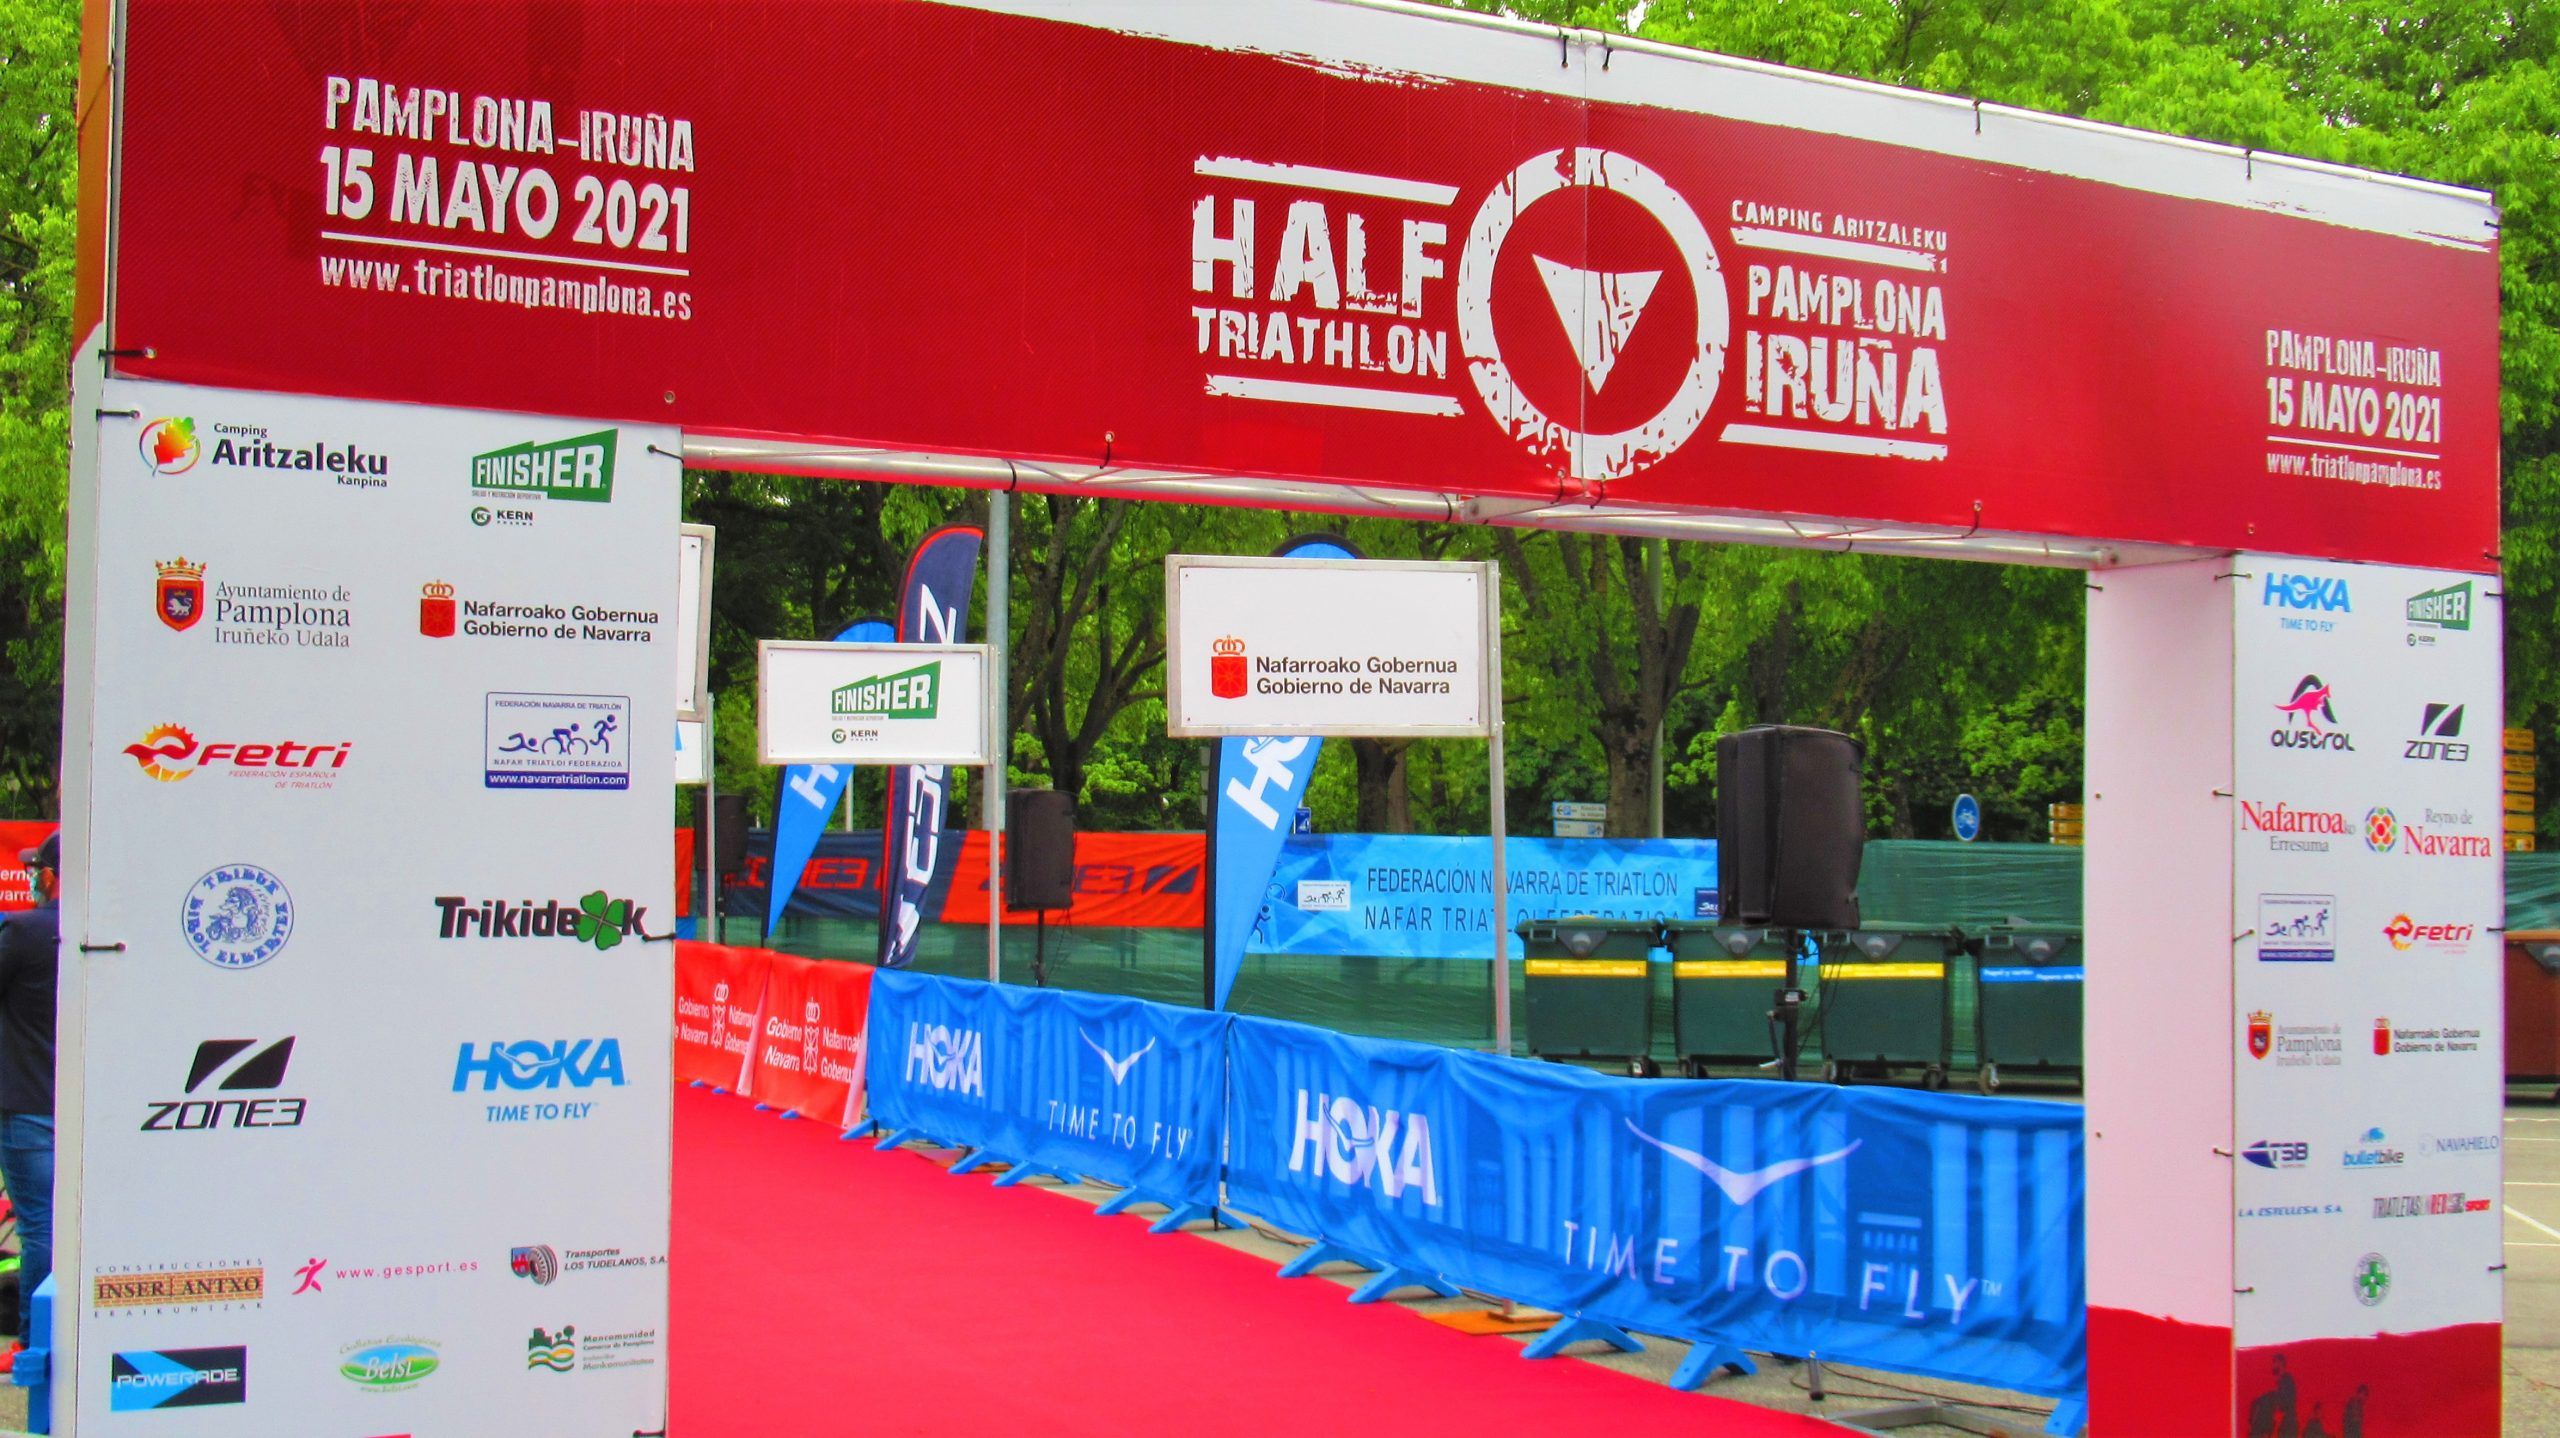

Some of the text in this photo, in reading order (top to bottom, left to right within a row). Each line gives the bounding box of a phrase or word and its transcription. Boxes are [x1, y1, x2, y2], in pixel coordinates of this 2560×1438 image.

[320, 146, 690, 254] 15 MAYO 2021
[1731, 200, 1948, 252] CAMPING ARITZALEKU
[1191, 195, 1448, 318] HALF
[320, 255, 692, 320] www.triatlonpamplona.es
[1747, 263, 1946, 340] PAMPLONA
[1191, 305, 1448, 379] TRIATHLON
[1746, 331, 1948, 435] IRUÑA
[2266, 377, 2440, 444] 15 MAYO 2021
[214, 423, 268, 438] Camping
[212, 438, 388, 475] Aritzaleku
[477, 445, 606, 489] FINISHER
[337, 474, 388, 488] Kanpina
[497, 510, 533, 521] KERN
[216, 581, 350, 602] Ayuntamiento de
[2263, 572, 2350, 613] HOKA
[216, 599, 350, 630] Pamplona
[464, 601, 659, 624] Nafarroako Gobernua
[2280, 617, 2303, 631] TIME
[2304, 619, 2317, 632] TO
[215, 627, 350, 648] Iruñeko Udala
[464, 619, 651, 642] Gobierno de Navarra
[1256, 656, 1457, 675] Nafarroako Gobernua
[835, 674, 932, 712] FINISHER
[1256, 677, 1450, 695] Gobierno de Navarra
[2404, 740, 2469, 762] ZONE3
[275, 781, 289, 789] DE
[489, 774, 627, 785] www.navarratriatlon.com
[2425, 808, 2473, 825] Reyno de
[2270, 836, 2329, 851] Erresuma
[2403, 825, 2492, 857] Navarra
[1367, 862, 1476, 895] FEDERACIÓN
[1481, 870, 1563, 896] NVARRA
[1566, 871, 1589, 896] DE
[1365, 905, 1433, 931] NAFAR
[679, 996, 710, 1019] Gobierno
[681, 1023, 709, 1046] Navarra
[766, 1016, 803, 1042] Gobierno
[2277, 1036, 2342, 1055] Pamplona
[452, 1037, 627, 1093] HOKA
[764, 1045, 800, 1071] Navarra
[905, 1021, 984, 1098] HOKA
[141, 1096, 307, 1131] ZONE3
[486, 1103, 529, 1122] TIME
[534, 1103, 559, 1121] TO
[1048, 1100, 1099, 1140] TIME
[1112, 1113, 1136, 1150] TO
[1288, 1088, 1437, 1206] HOKA
[2269, 1142, 2308, 1161] TSB
[565, 1247, 620, 1259] Transportes
[1562, 1219, 1678, 1286] TIME
[1724, 1244, 1808, 1301] TO
[336, 1260, 478, 1280] www.gesport.es
[564, 1260, 584, 1271] LOS
[97, 1276, 260, 1300] INSER ANTXO
[117, 1368, 238, 1388] POWERADE
